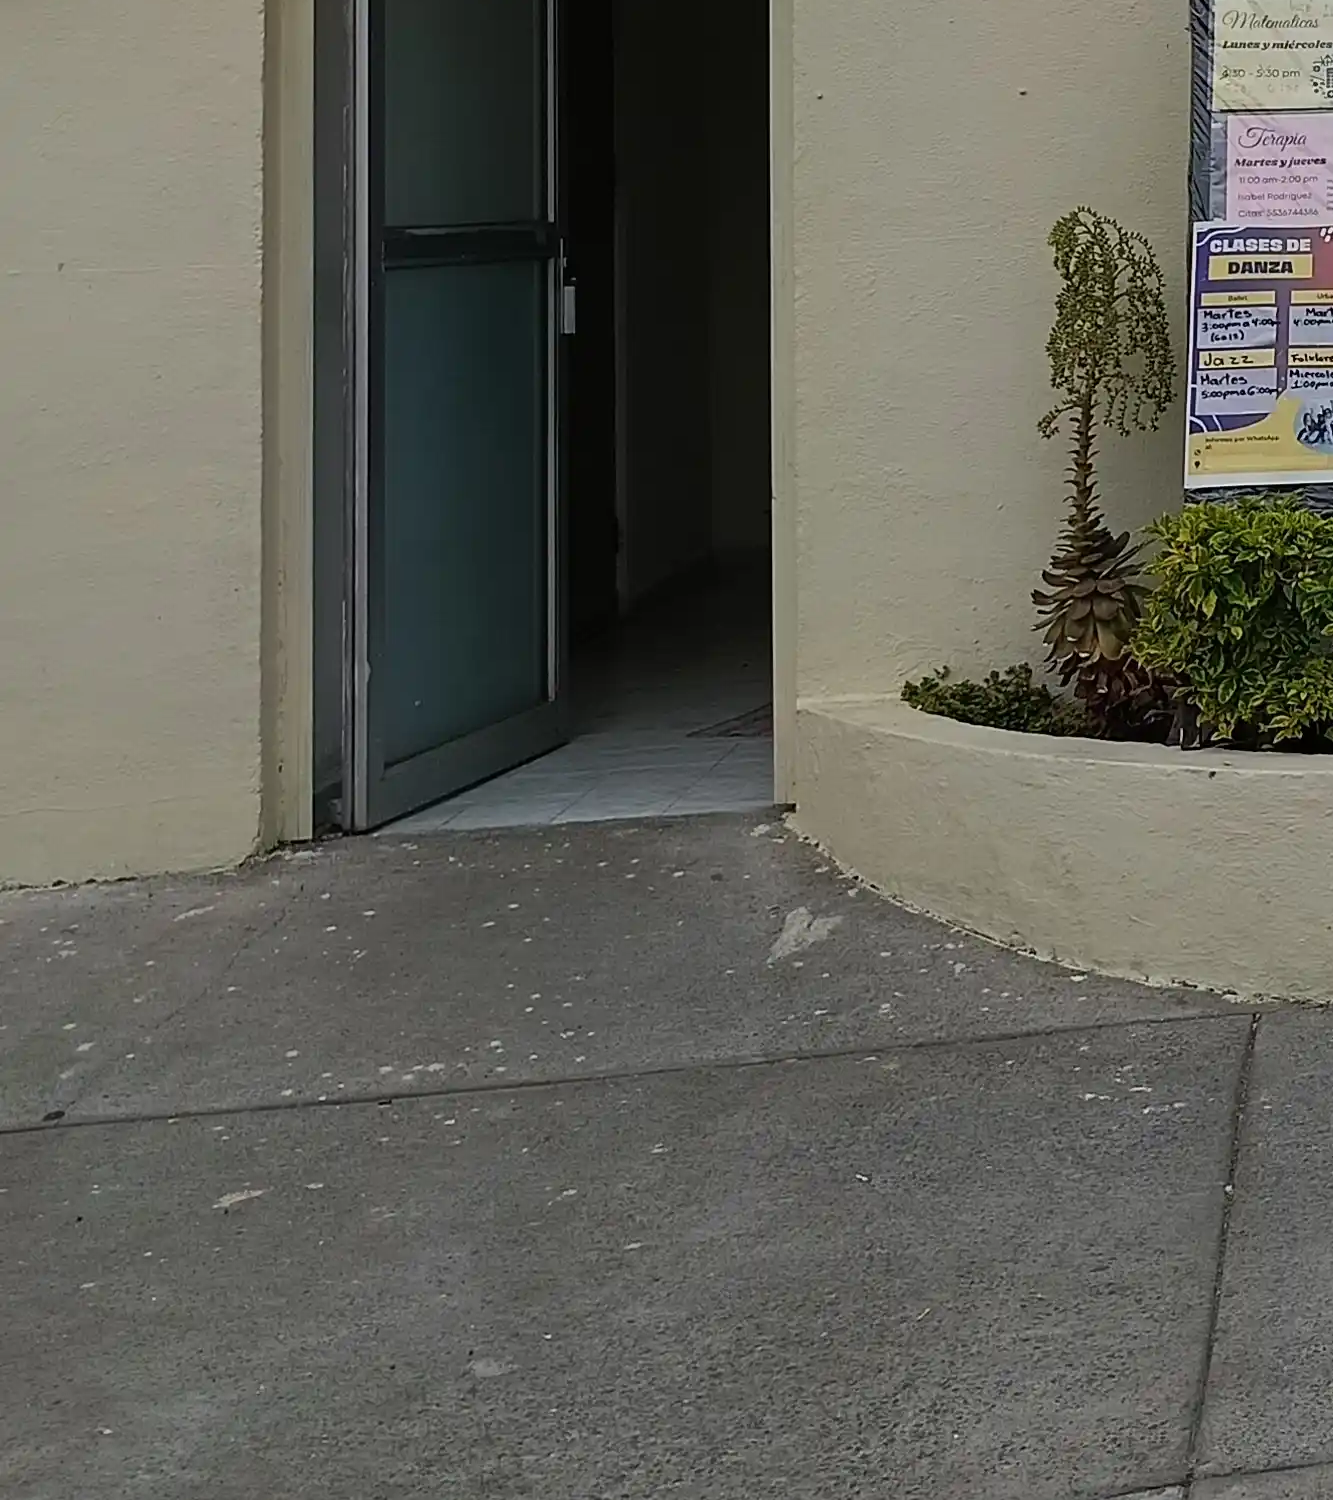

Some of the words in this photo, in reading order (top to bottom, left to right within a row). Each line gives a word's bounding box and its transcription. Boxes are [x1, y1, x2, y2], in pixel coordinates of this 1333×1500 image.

[1221, 40, 1261, 50] Lunes
[1261, 41, 1270, 52] y
[1271, 39, 1333, 50] miércoles
[1281, 70, 1301, 79] pm
[1237, 126, 1308, 152] Terapia
[1234, 157, 1278, 169] Martes
[1279, 158, 1288, 170] y
[1287, 157, 1328, 169] jueves
[1302, 175, 1319, 184] pm
[1209, 238, 1283, 253] CLASES
[1286, 238, 1312, 252] DE
[1227, 261, 1294, 275] DANZA
[1203, 308, 1253, 320] Martes
[1203, 352, 1254, 367] Jazz
[1200, 373, 1248, 386] Martes
